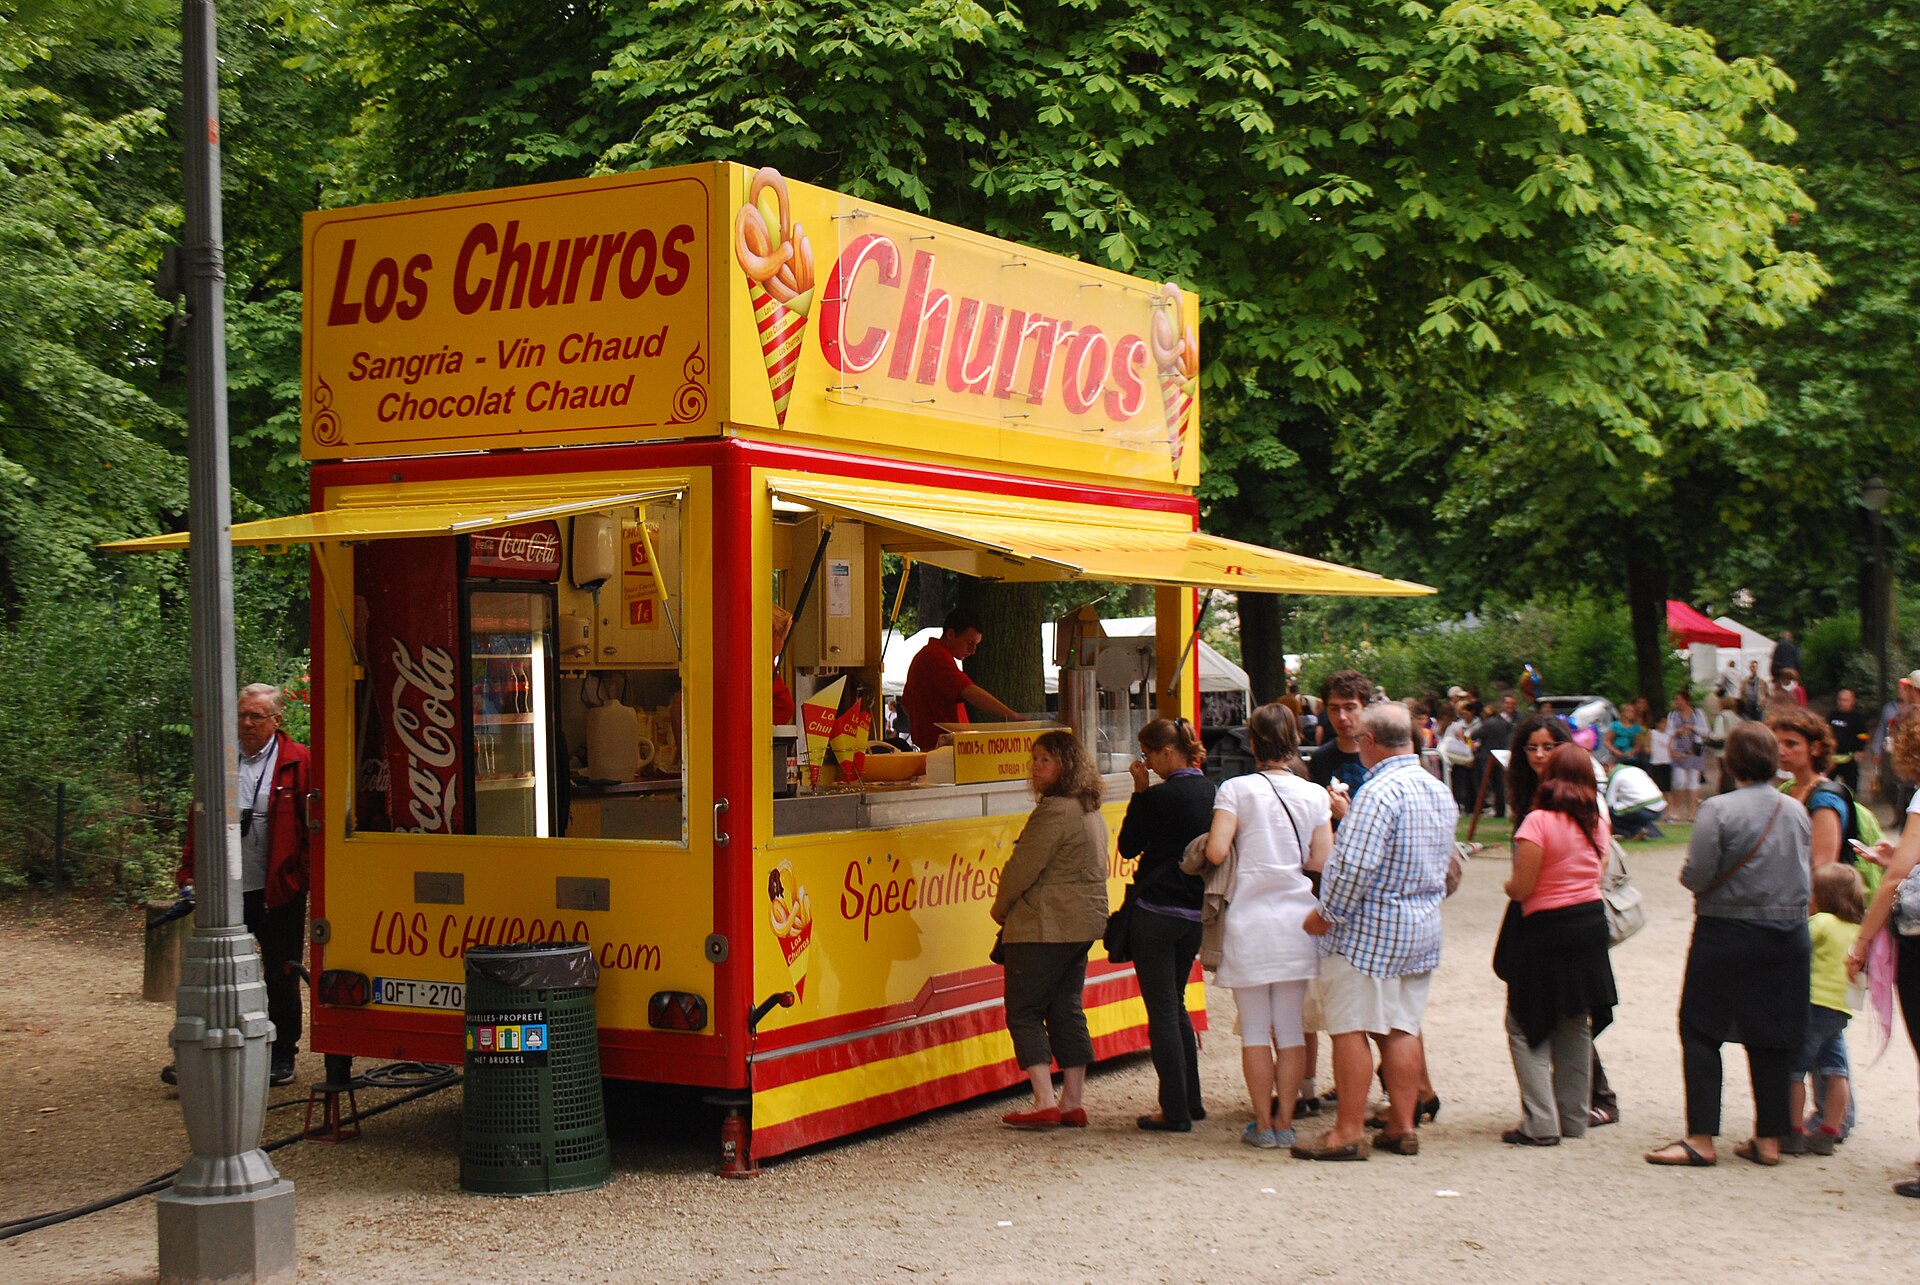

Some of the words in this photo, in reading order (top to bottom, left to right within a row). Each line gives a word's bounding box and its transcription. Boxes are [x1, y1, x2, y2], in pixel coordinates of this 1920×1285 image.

[327, 239, 432, 327] Los
[453, 219, 696, 317] Churros
[819, 233, 1149, 423] Churros
[348, 344, 464, 385] Sangria
[497, 338, 546, 370] Vin
[558, 325, 669, 366] Chaud
[377, 384, 517, 424] Chocolat
[525, 374, 636, 413] Chaud
[988, 737, 1021, 755] MEDIUM
[840, 849, 1000, 942] Spécialités
[370, 910, 428, 955] LOS
[600, 942, 661, 972] com
[787, 936, 811, 965] Churros
[790, 934, 802, 951] Los
[375, 992, 381, 1001] B
[474, 1056, 486, 1064] NET
[489, 1056, 525, 1064] BRUSSEL
